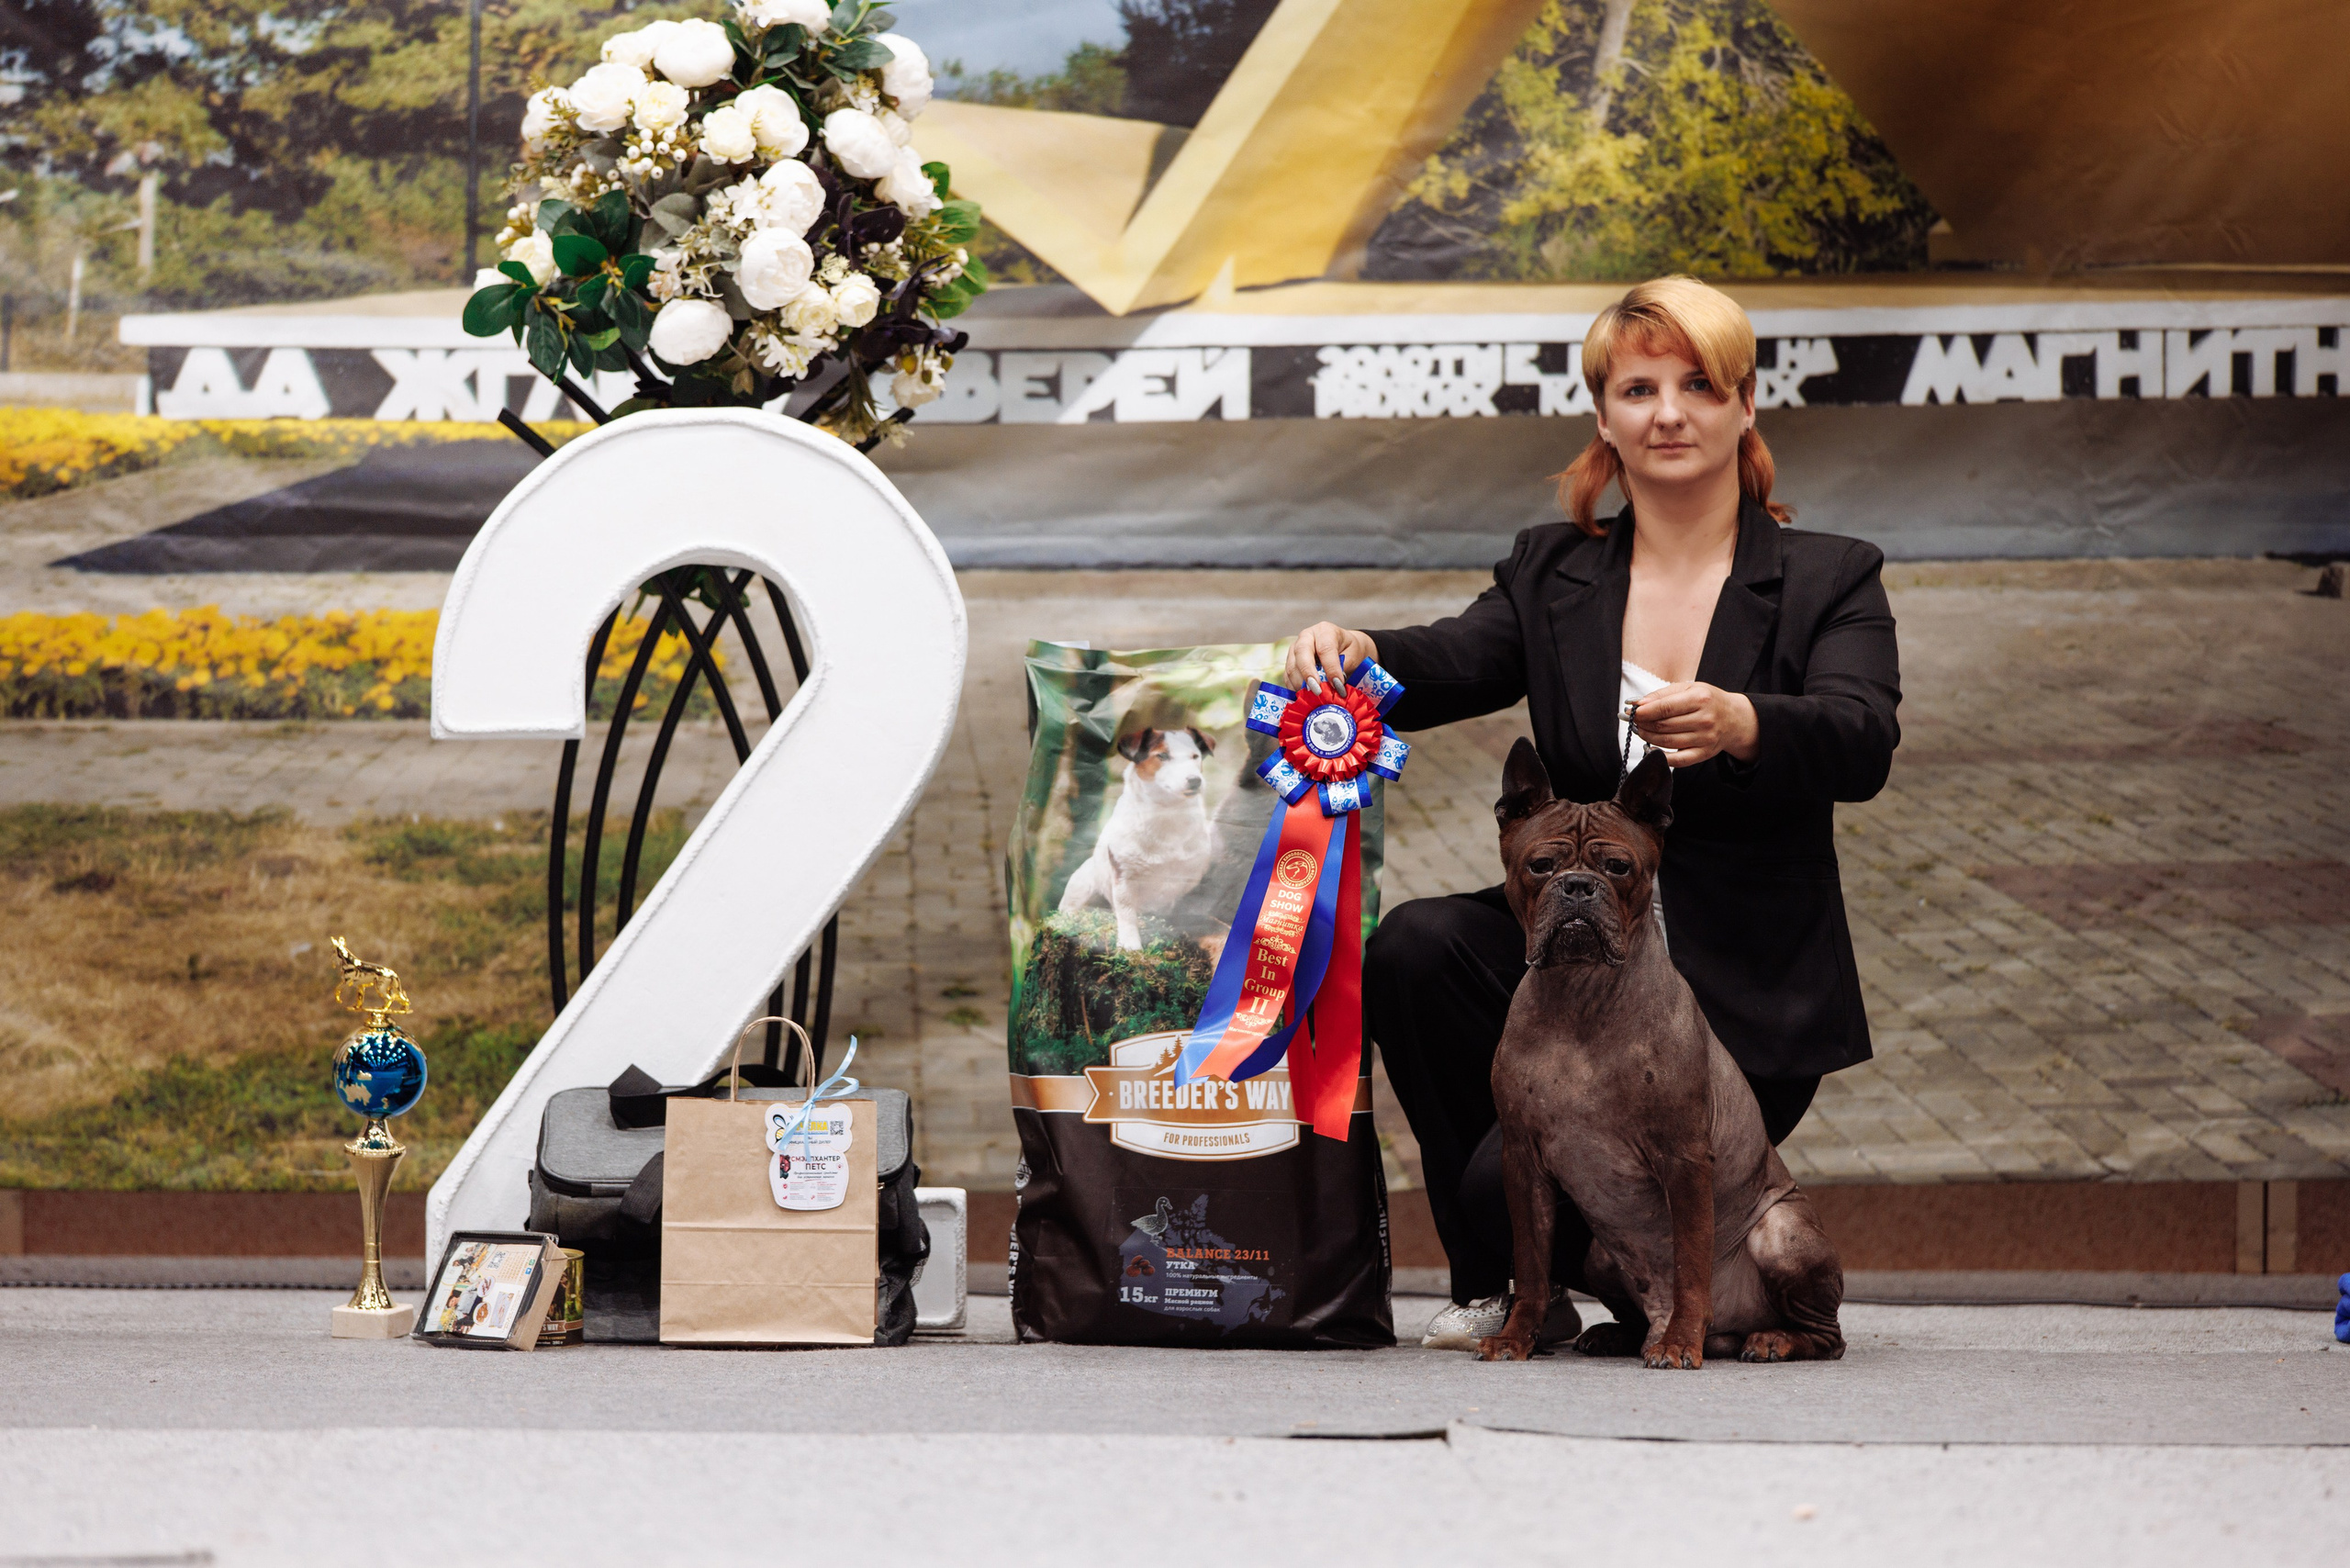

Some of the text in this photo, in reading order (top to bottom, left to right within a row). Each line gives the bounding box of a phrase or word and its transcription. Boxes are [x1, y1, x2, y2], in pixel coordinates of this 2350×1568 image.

[426, 406, 968, 1336] 2
[1278, 889, 1303, 902] DOG
[1270, 899, 1304, 913] SHOW
[1259, 914, 1304, 932] Магнитка
[1256, 947, 1289, 968] Best
[1260, 965, 1276, 981] In
[1244, 978, 1286, 1002] Group
[1248, 995, 1270, 1016] II
[1119, 1080, 1291, 1111] BREEDER'S WAY
[1163, 1132, 1250, 1148] FOR PROFESSIONALS
[1166, 1247, 1270, 1261] BALANCE 23/11
[1166, 1260, 1196, 1270] УТКА
[1165, 1287, 1218, 1298] ПРЕМИУМ
